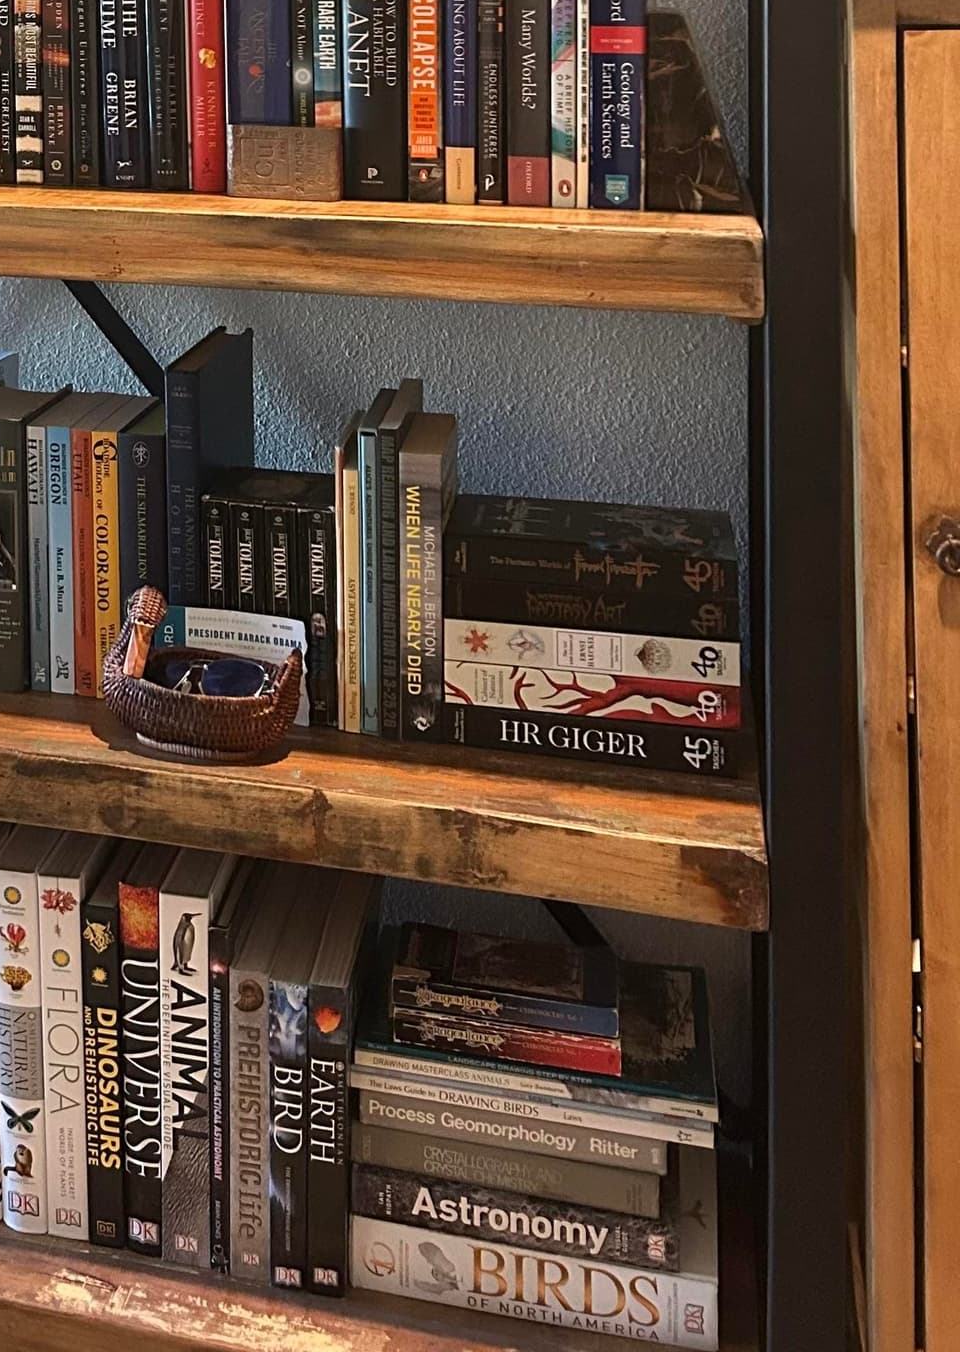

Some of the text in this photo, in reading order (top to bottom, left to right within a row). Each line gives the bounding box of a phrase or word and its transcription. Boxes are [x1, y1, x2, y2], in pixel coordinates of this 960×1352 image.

[318, 0, 336, 69] RARE EARTH
[518, 9, 536, 110] Many Worlds?
[106, 72, 119, 136] GREENE
[124, 79, 136, 129] BRIAN
[601, 64, 616, 160] Earth Sciences
[620, 62, 634, 148] Geology and
[50, 442, 62, 506] OREGON
[96, 513, 110, 614] COLORADO
[406, 484, 422, 696] WHEN LIFE NEARLY DIED
[424, 524, 436, 657] MICHAEL BENTON
[188, 627, 303, 650] PRESIDENT BARACK OBAMA
[499, 720, 542, 746] HR
[547, 724, 647, 758] GIGER
[46, 986, 82, 1115] FLORA
[96, 1008, 121, 1170] DINOSAURS
[121, 958, 162, 1182] UNIVERSE
[274, 1064, 302, 1155] BIRD
[310, 1056, 335, 1164] EARTH
[368, 1099, 638, 1160] Process Geomorphology Ritter
[437, 1089, 540, 1116] DRAWING BIRDS
[411, 1187, 608, 1255] Astronomy
[466, 1244, 660, 1328] BIRDS
[466, 1296, 660, 1341] OF NORTH AMERICA
